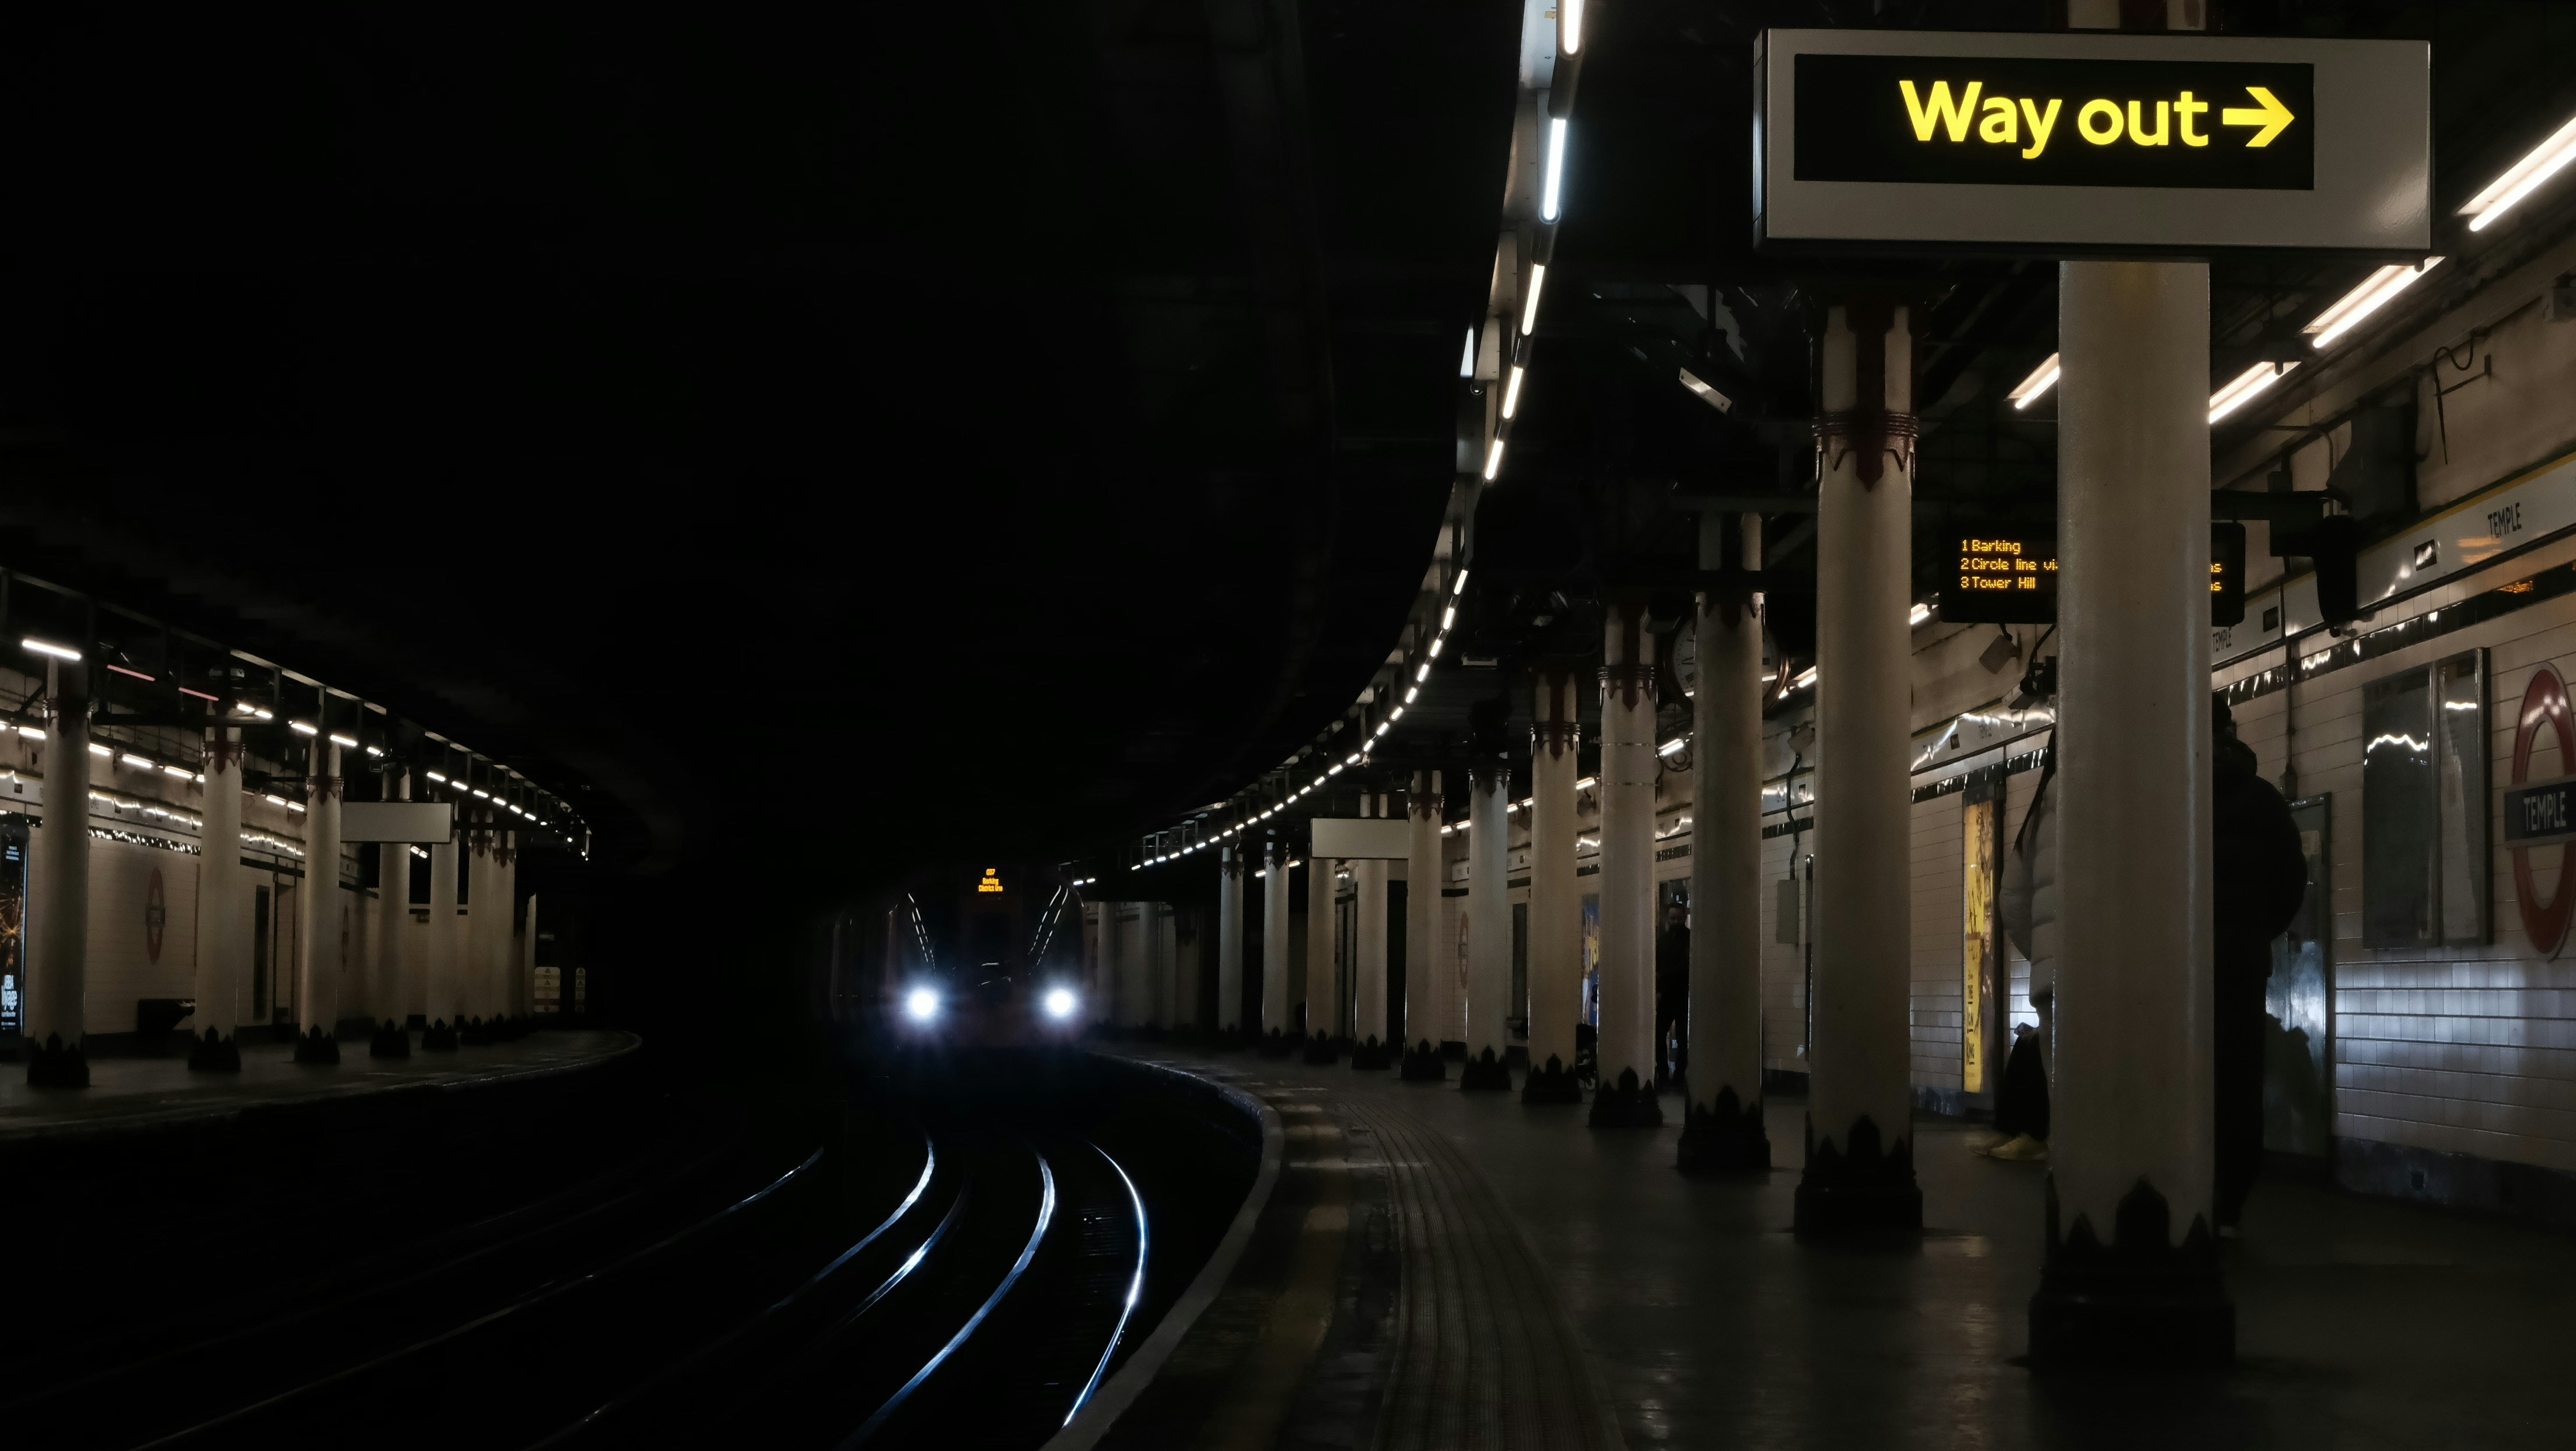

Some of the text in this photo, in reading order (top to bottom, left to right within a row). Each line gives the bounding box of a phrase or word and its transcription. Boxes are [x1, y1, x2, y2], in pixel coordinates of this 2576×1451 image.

[1899, 80, 2209, 159] Way out
[2487, 502, 2522, 539] TEMPLE
[1962, 539, 2021, 555] 1 Barking
[1961, 558, 2059, 571] 2 Circle line vi
[1961, 576, 2036, 589] 3 Tower Hill
[2213, 626, 2232, 653] TEMPLE
[2524, 791, 2567, 832] TEMPLE
